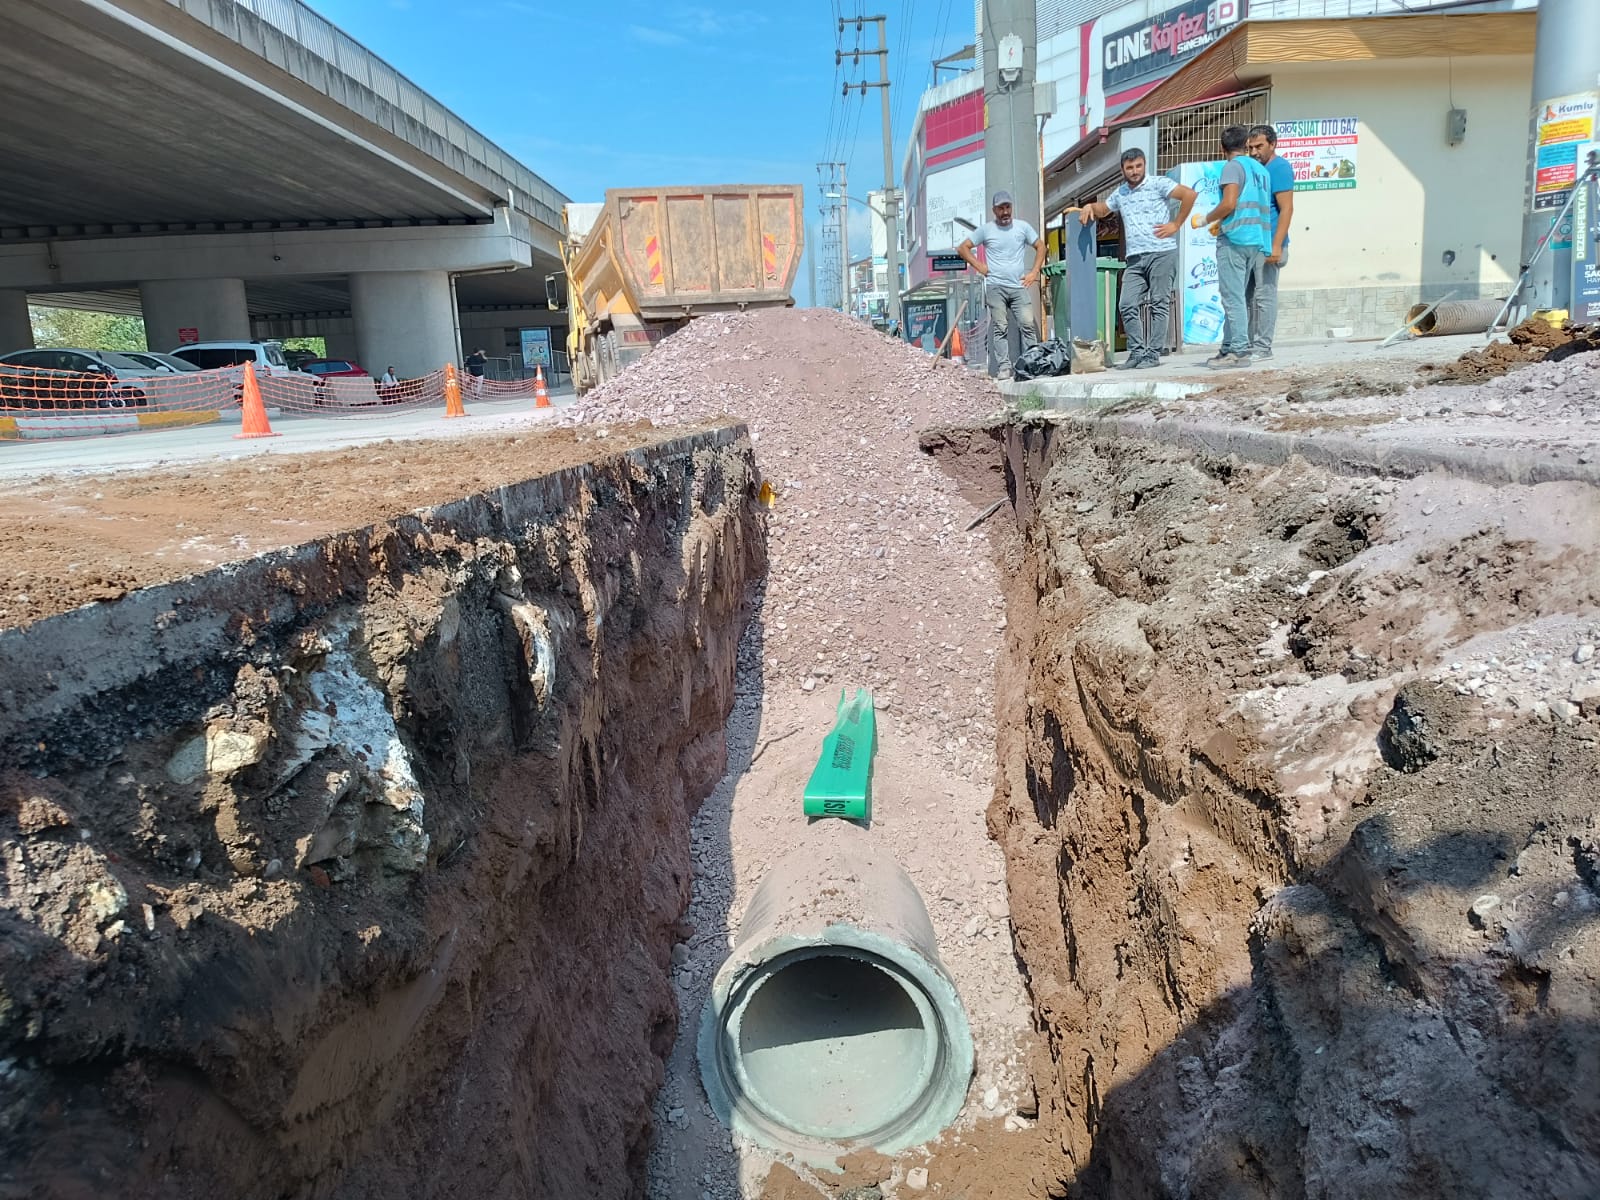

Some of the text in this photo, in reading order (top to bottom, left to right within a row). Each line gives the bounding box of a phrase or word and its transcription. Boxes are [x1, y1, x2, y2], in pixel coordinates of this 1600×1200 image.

[1559, 102, 1593, 114] Kumlu
[1298, 121, 1320, 136] SUAT
[1321, 120, 1338, 135] OTO
[1340, 119, 1357, 134] GAZ
